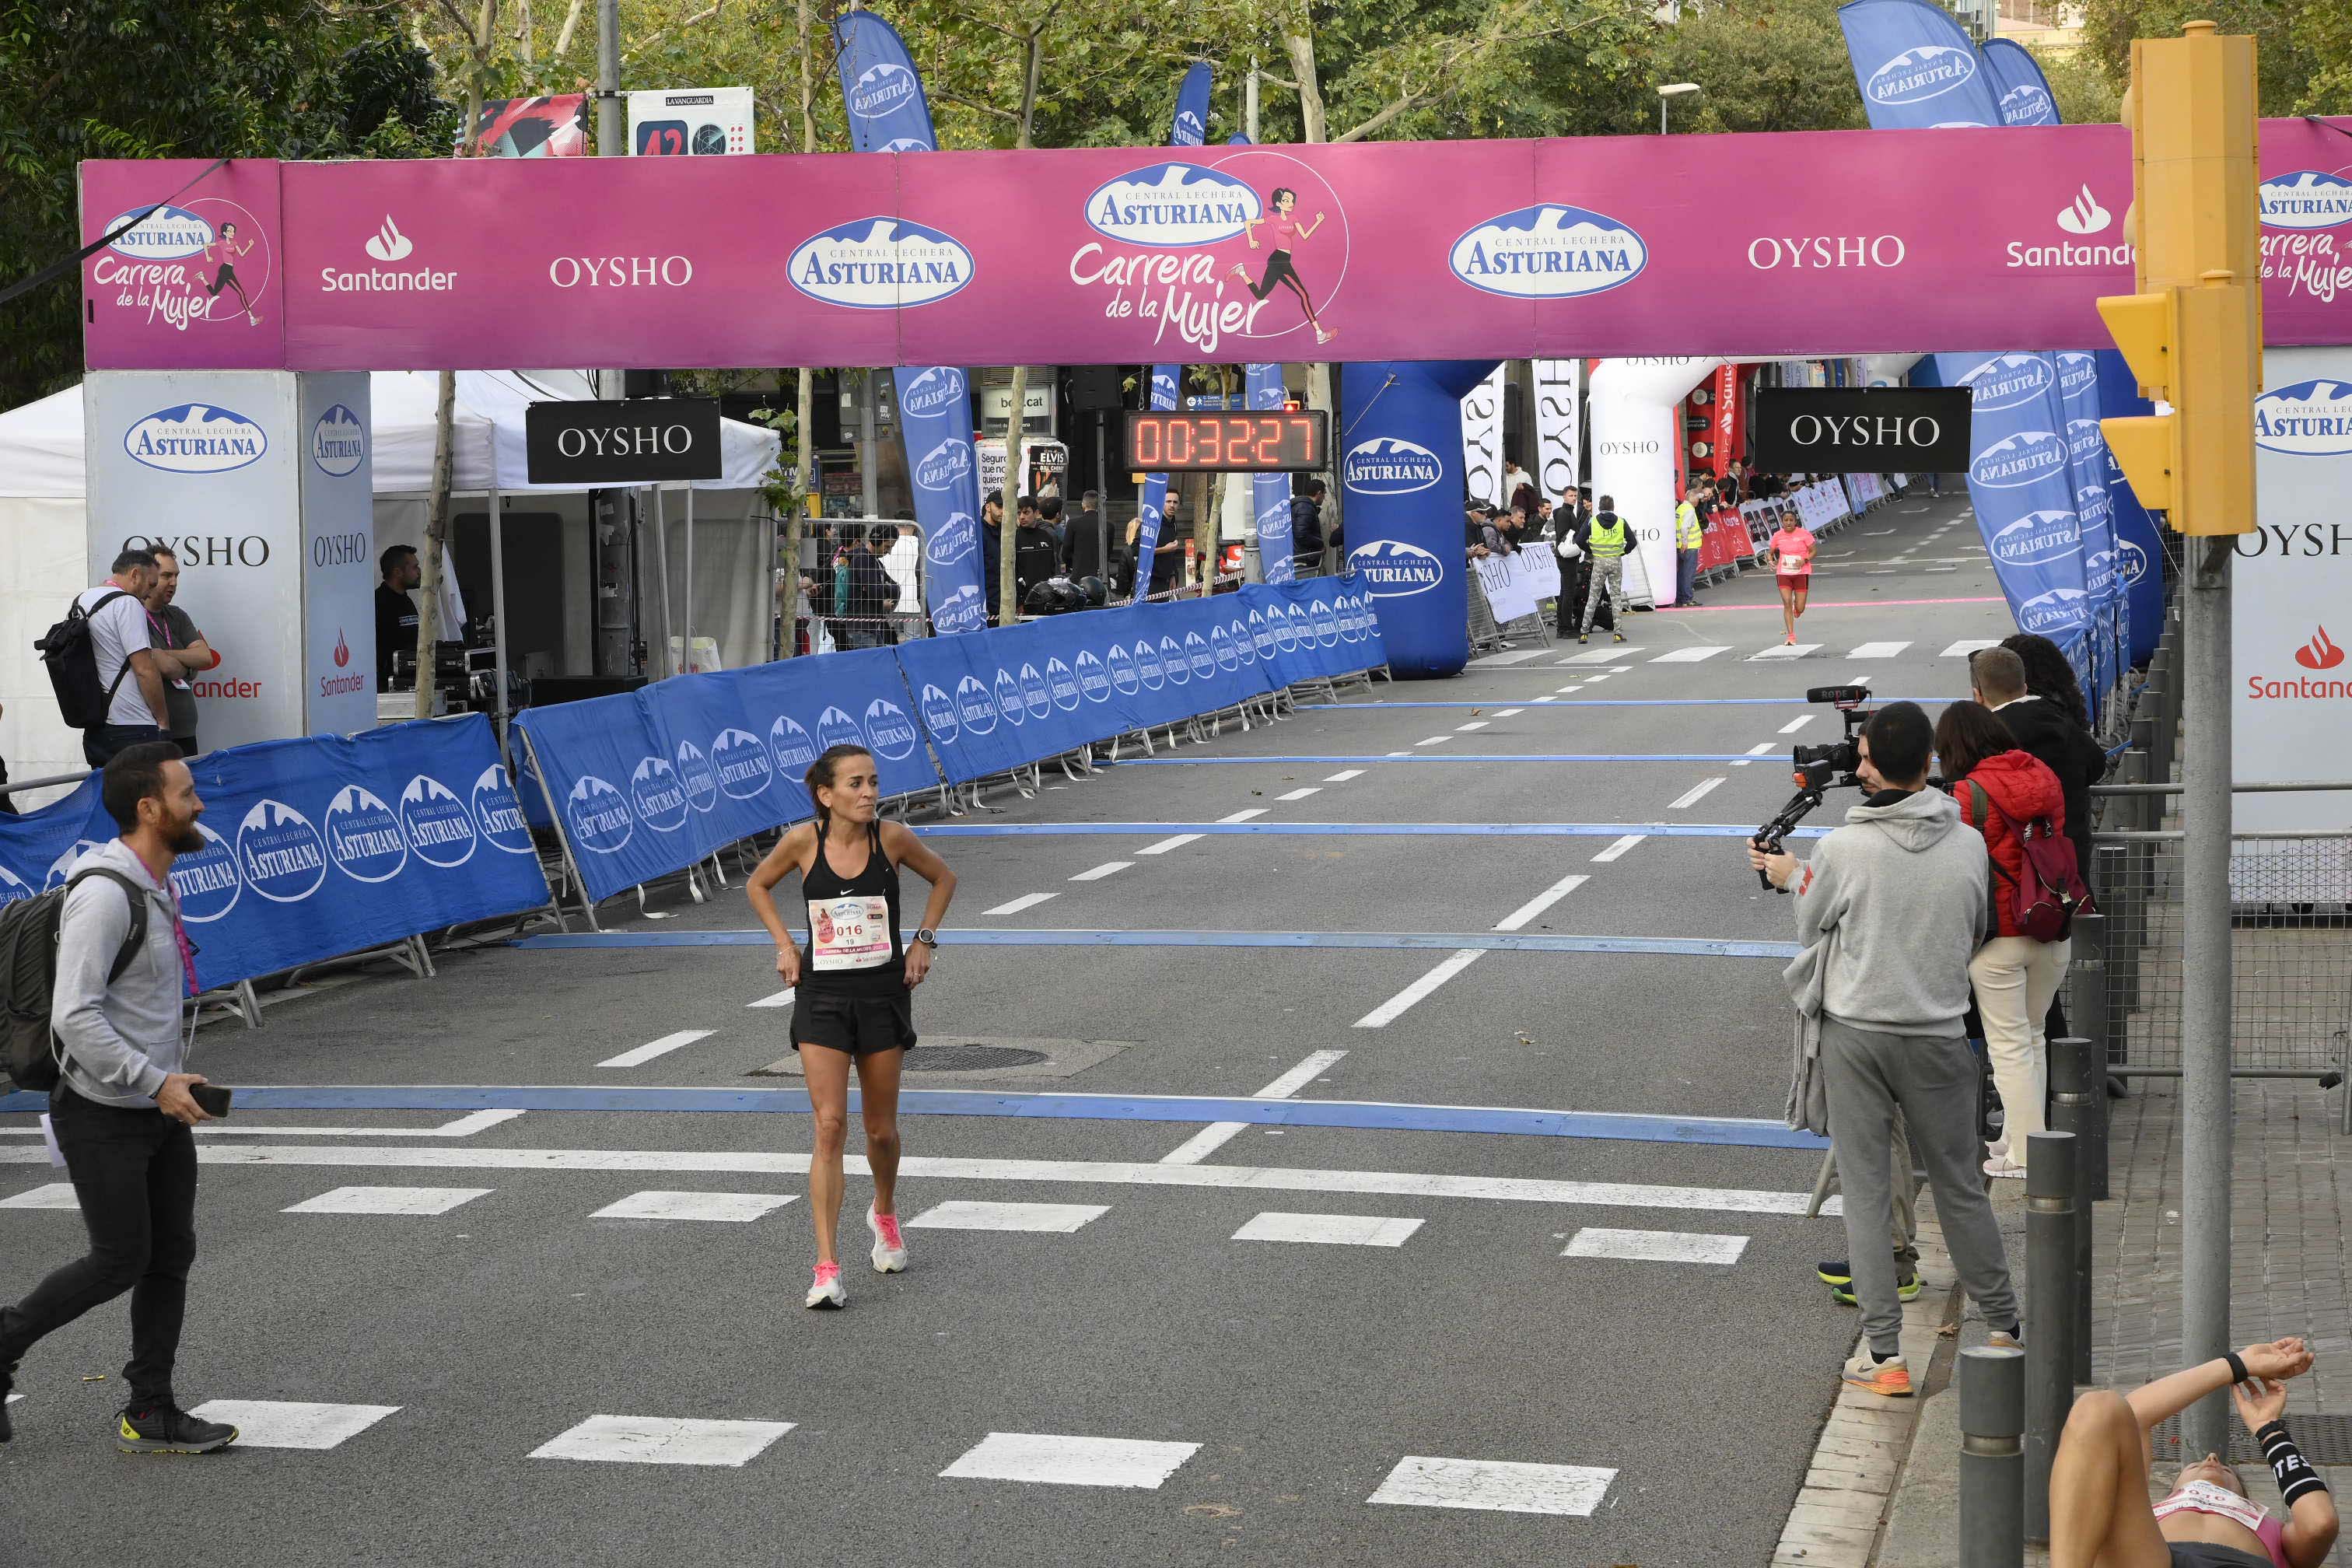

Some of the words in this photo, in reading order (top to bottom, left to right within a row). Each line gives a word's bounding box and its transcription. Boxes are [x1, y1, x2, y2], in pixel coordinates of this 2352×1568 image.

[1098, 194, 1246, 226] ASTURIANA
[830, 249, 888, 258] CENTRAL
[894, 248, 953, 257] LECHERA
[1496, 236, 1556, 247] CENTRAL
[1563, 236, 1626, 246] LECHERA
[1748, 234, 1906, 269] OYSHO
[2259, 233, 2334, 256] arrera
[93, 256, 187, 285] Carrera
[549, 255, 692, 288] OYSHO
[801, 251, 961, 285] ASTURIANA
[1069, 242, 1216, 286] Carrera
[1465, 240, 1632, 275] ASTURIANA
[2278, 256, 2292, 278] la
[321, 267, 457, 292] Santander
[117, 285, 133, 306] de
[137, 285, 149, 306] la
[147, 282, 221, 331] Mujer
[1105, 288, 1132, 317] de
[1138, 286, 1158, 317] la
[1153, 280, 1269, 353] Mujer
[135, 429, 257, 456] ASTURIANA
[317, 432, 362, 459] ASTURIANA
[558, 424, 693, 457] OYSHO
[1138, 419, 1311, 464] 00:32:27
[1790, 415, 1940, 446] OYSHO
[1040, 453, 1064, 463] ELVIS
[1600, 440, 1659, 456] OYSHO
[982, 475, 1007, 485] quiere
[1347, 460, 1435, 482] ASTURIANA
[314, 532, 366, 567] OYSHO
[1349, 562, 1436, 583] TURIANA
[320, 671, 365, 697] Santander
[333, 824, 404, 862] ASTURIANA
[407, 812, 473, 848] ASTURIANA
[245, 842, 323, 882] ASTURIANA
